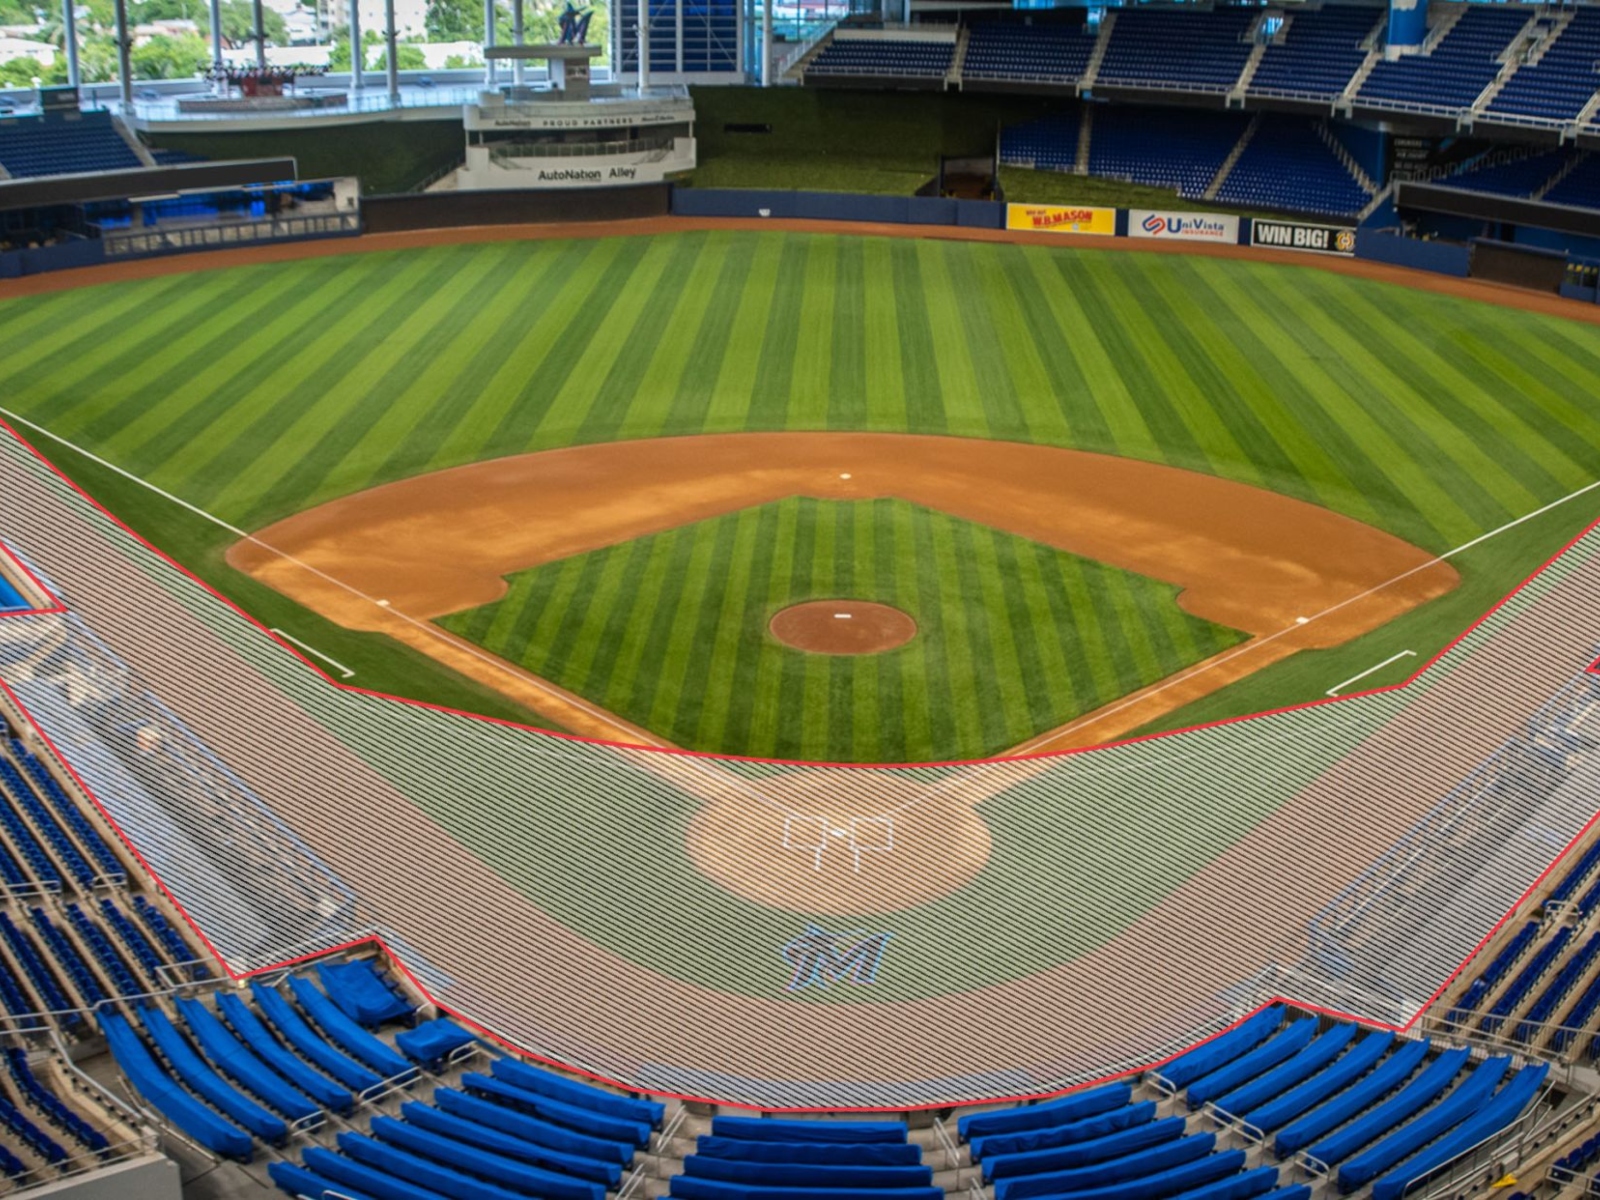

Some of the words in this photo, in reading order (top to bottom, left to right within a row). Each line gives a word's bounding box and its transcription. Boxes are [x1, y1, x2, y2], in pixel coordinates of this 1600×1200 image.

[583, 117, 633, 127] PARTNERS
[538, 170, 601, 181] AutoNation
[608, 167, 636, 179] Alley
[1167, 217, 1224, 233] UniVista
[1181, 229, 1223, 237] INSURANCE
[1258, 223, 1292, 245] WIN
[1294, 227, 1329, 249] BIG!
